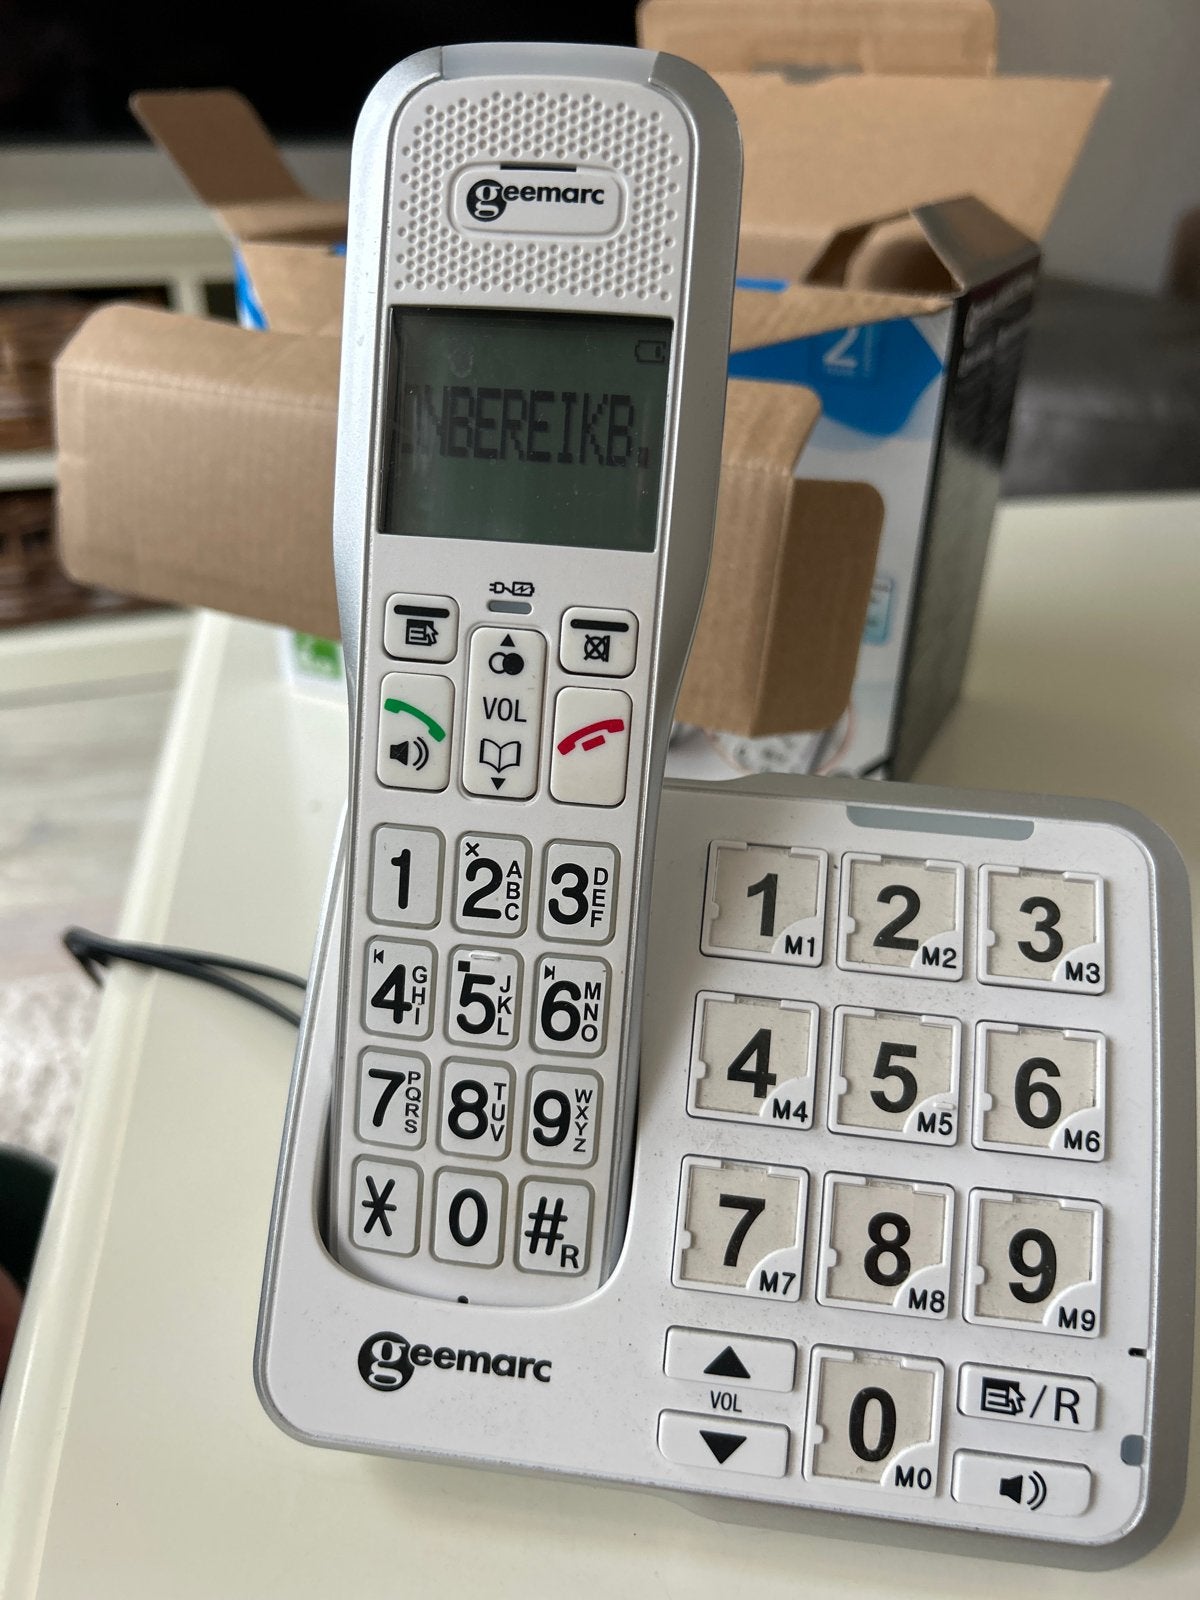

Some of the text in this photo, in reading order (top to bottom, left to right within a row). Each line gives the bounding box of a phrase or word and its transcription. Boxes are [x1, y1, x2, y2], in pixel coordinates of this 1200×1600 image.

[465, 178, 605, 223] geemarc
[482, 696, 528, 723] VOL
[390, 848, 412, 910] 1
[461, 857, 504, 920] 2
[547, 863, 589, 925] 3
[746, 872, 815, 958] 1 M1
[872, 884, 957, 970] 2 M2
[1017, 896, 1101, 984] 3 M3
[370, 963, 413, 1025] 4
[456, 973, 496, 1035] 5
[540, 980, 582, 1042] 6
[367, 1068, 406, 1128] 7
[726, 1028, 809, 1123] 4 M4
[870, 1041, 953, 1136] 5 M5
[1014, 1057, 1101, 1153] 6 M6
[447, 1079, 489, 1141] 8
[532, 1089, 572, 1148] 9
[448, 1188, 489, 1248] 0
[718, 1193, 797, 1296] 7 M7
[560, 1244, 580, 1269] R
[863, 1211, 946, 1314] 8 M8
[1008, 1228, 1096, 1332] 9 M9
[357, 1331, 553, 1393] geemarc
[710, 1390, 743, 1413] VOL
[848, 1386, 897, 1463] 0
